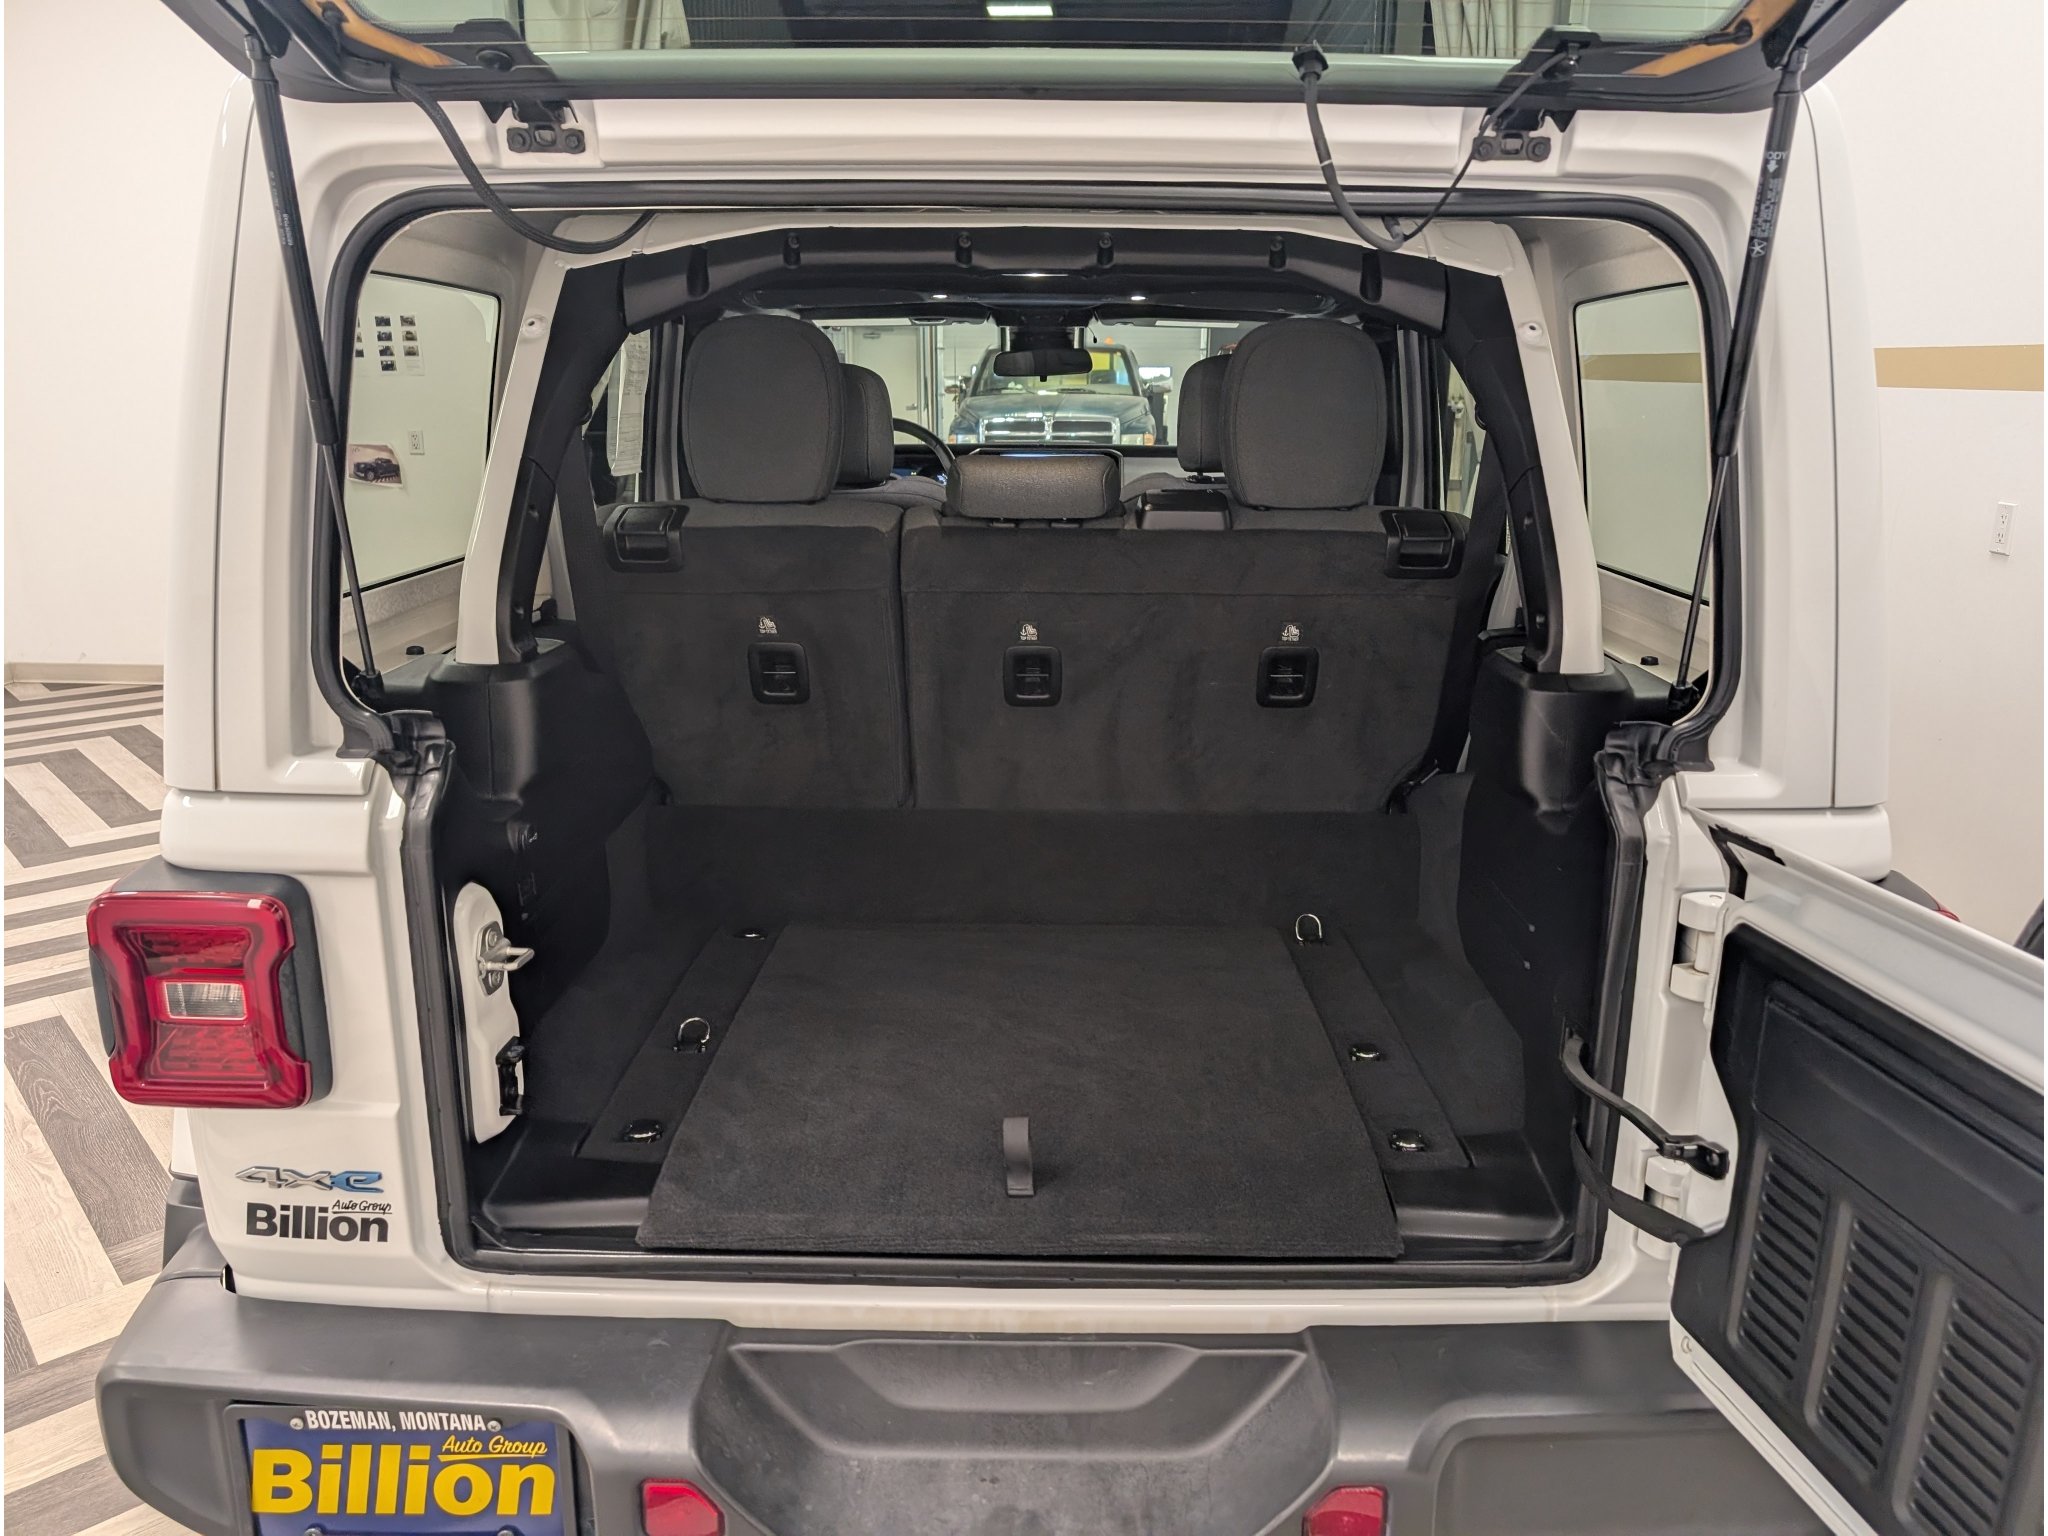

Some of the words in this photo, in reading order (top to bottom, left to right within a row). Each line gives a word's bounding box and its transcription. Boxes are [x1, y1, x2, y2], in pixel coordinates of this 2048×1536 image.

[332, 1200, 359, 1211] Auto
[359, 1201, 392, 1215] Group
[246, 1202, 389, 1242] Billion
[304, 1410, 397, 1432] BOZEMAN,
[399, 1411, 487, 1431] MONTANA
[442, 1435, 482, 1453] Auto
[488, 1435, 548, 1459] Group
[251, 1444, 556, 1517] Billion
